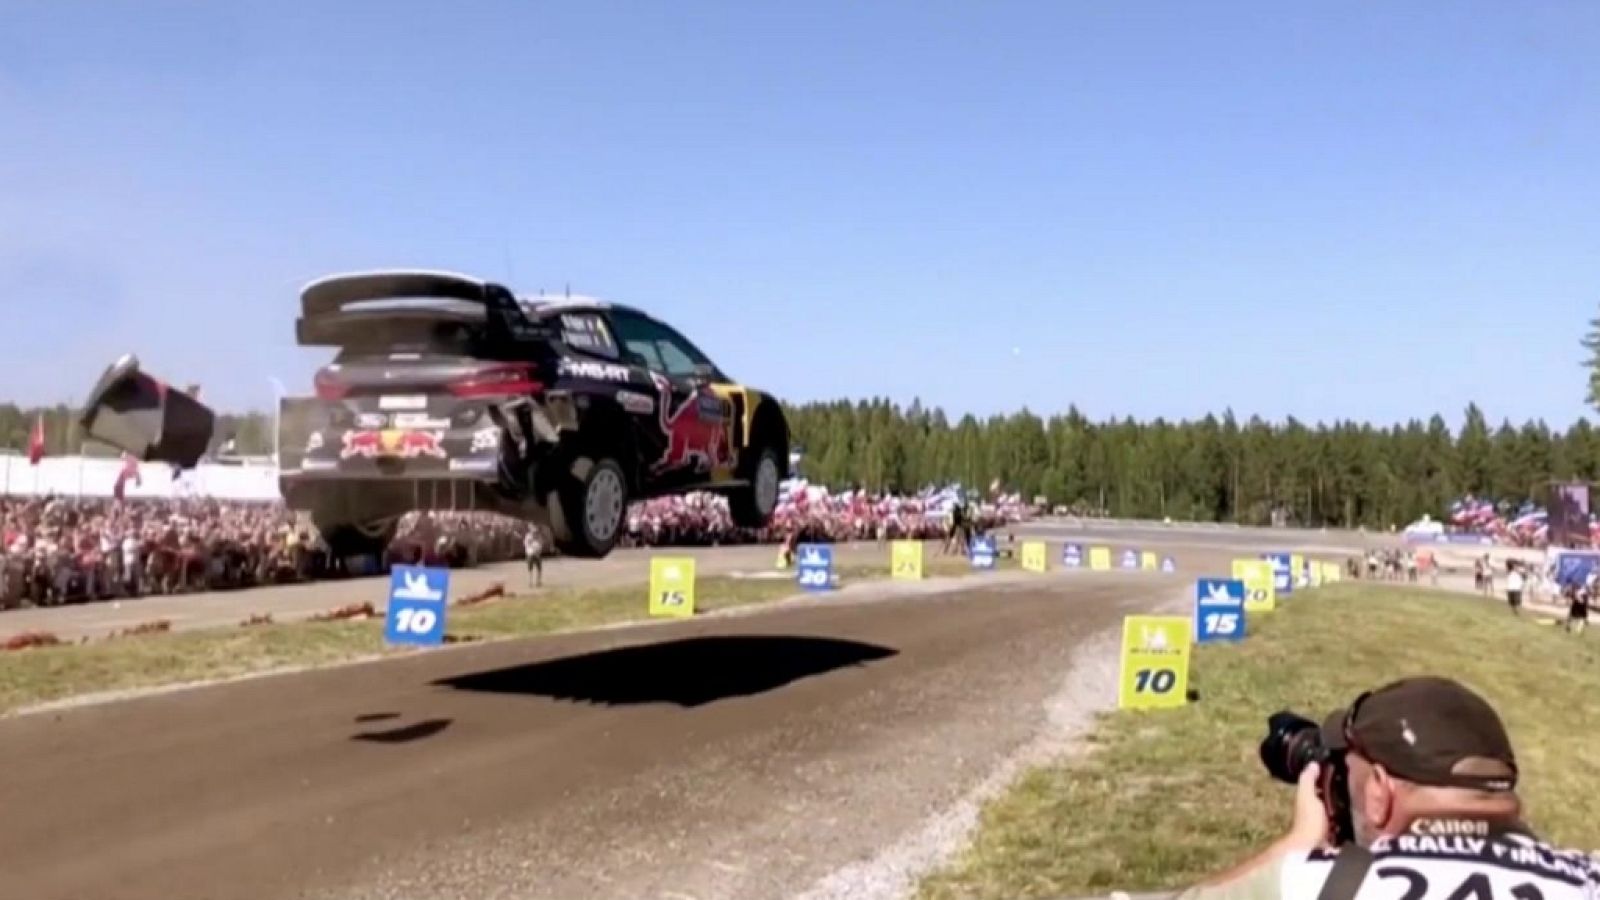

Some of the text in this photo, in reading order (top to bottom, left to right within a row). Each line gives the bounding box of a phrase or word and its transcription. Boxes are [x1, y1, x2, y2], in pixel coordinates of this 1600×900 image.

[799, 568, 827, 585] 20
[661, 591, 684, 606] 15
[396, 608, 436, 634] 10
[1205, 613, 1240, 634] 15
[1135, 669, 1176, 694] 10
[1410, 818, 1489, 836] Canon
[1398, 834, 1485, 856] RALLY
